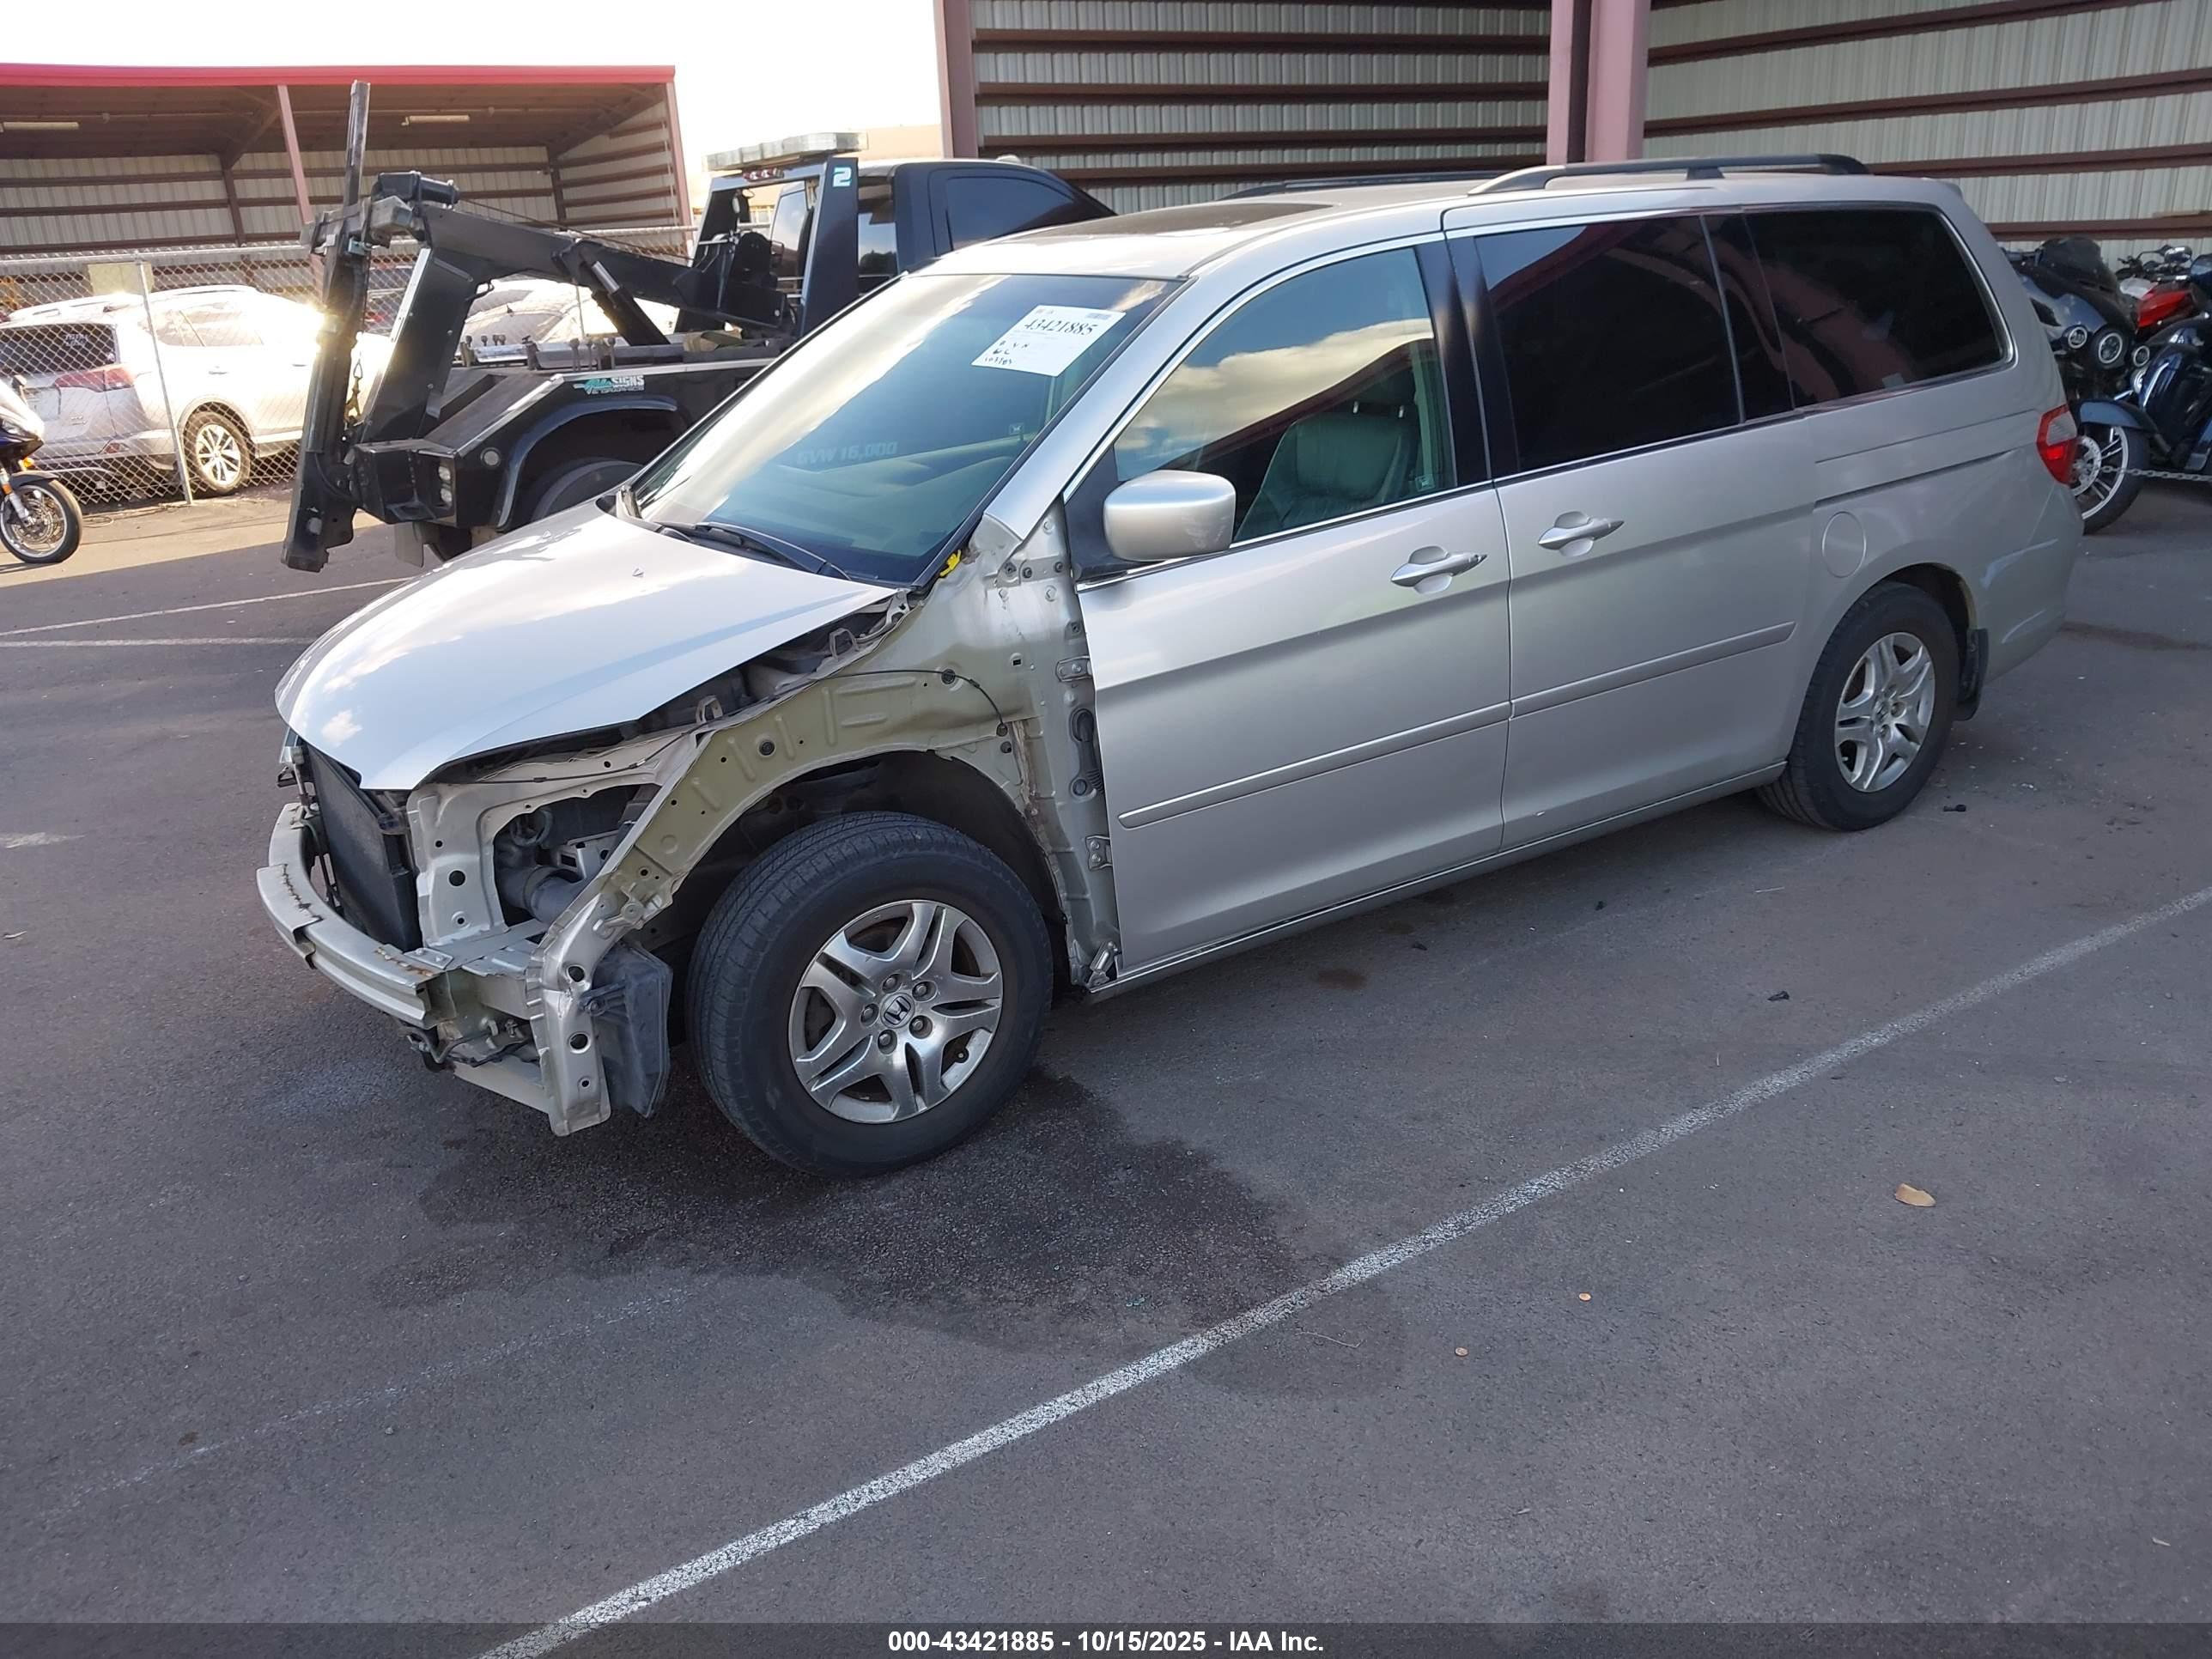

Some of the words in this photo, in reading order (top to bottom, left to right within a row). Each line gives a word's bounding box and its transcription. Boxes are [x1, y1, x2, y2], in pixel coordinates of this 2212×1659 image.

[833, 167, 852, 187] 2
[1024, 319, 1098, 336] 43421885
[611, 374, 645, 386] SIGNS
[840, 441, 898, 461] 16,000
